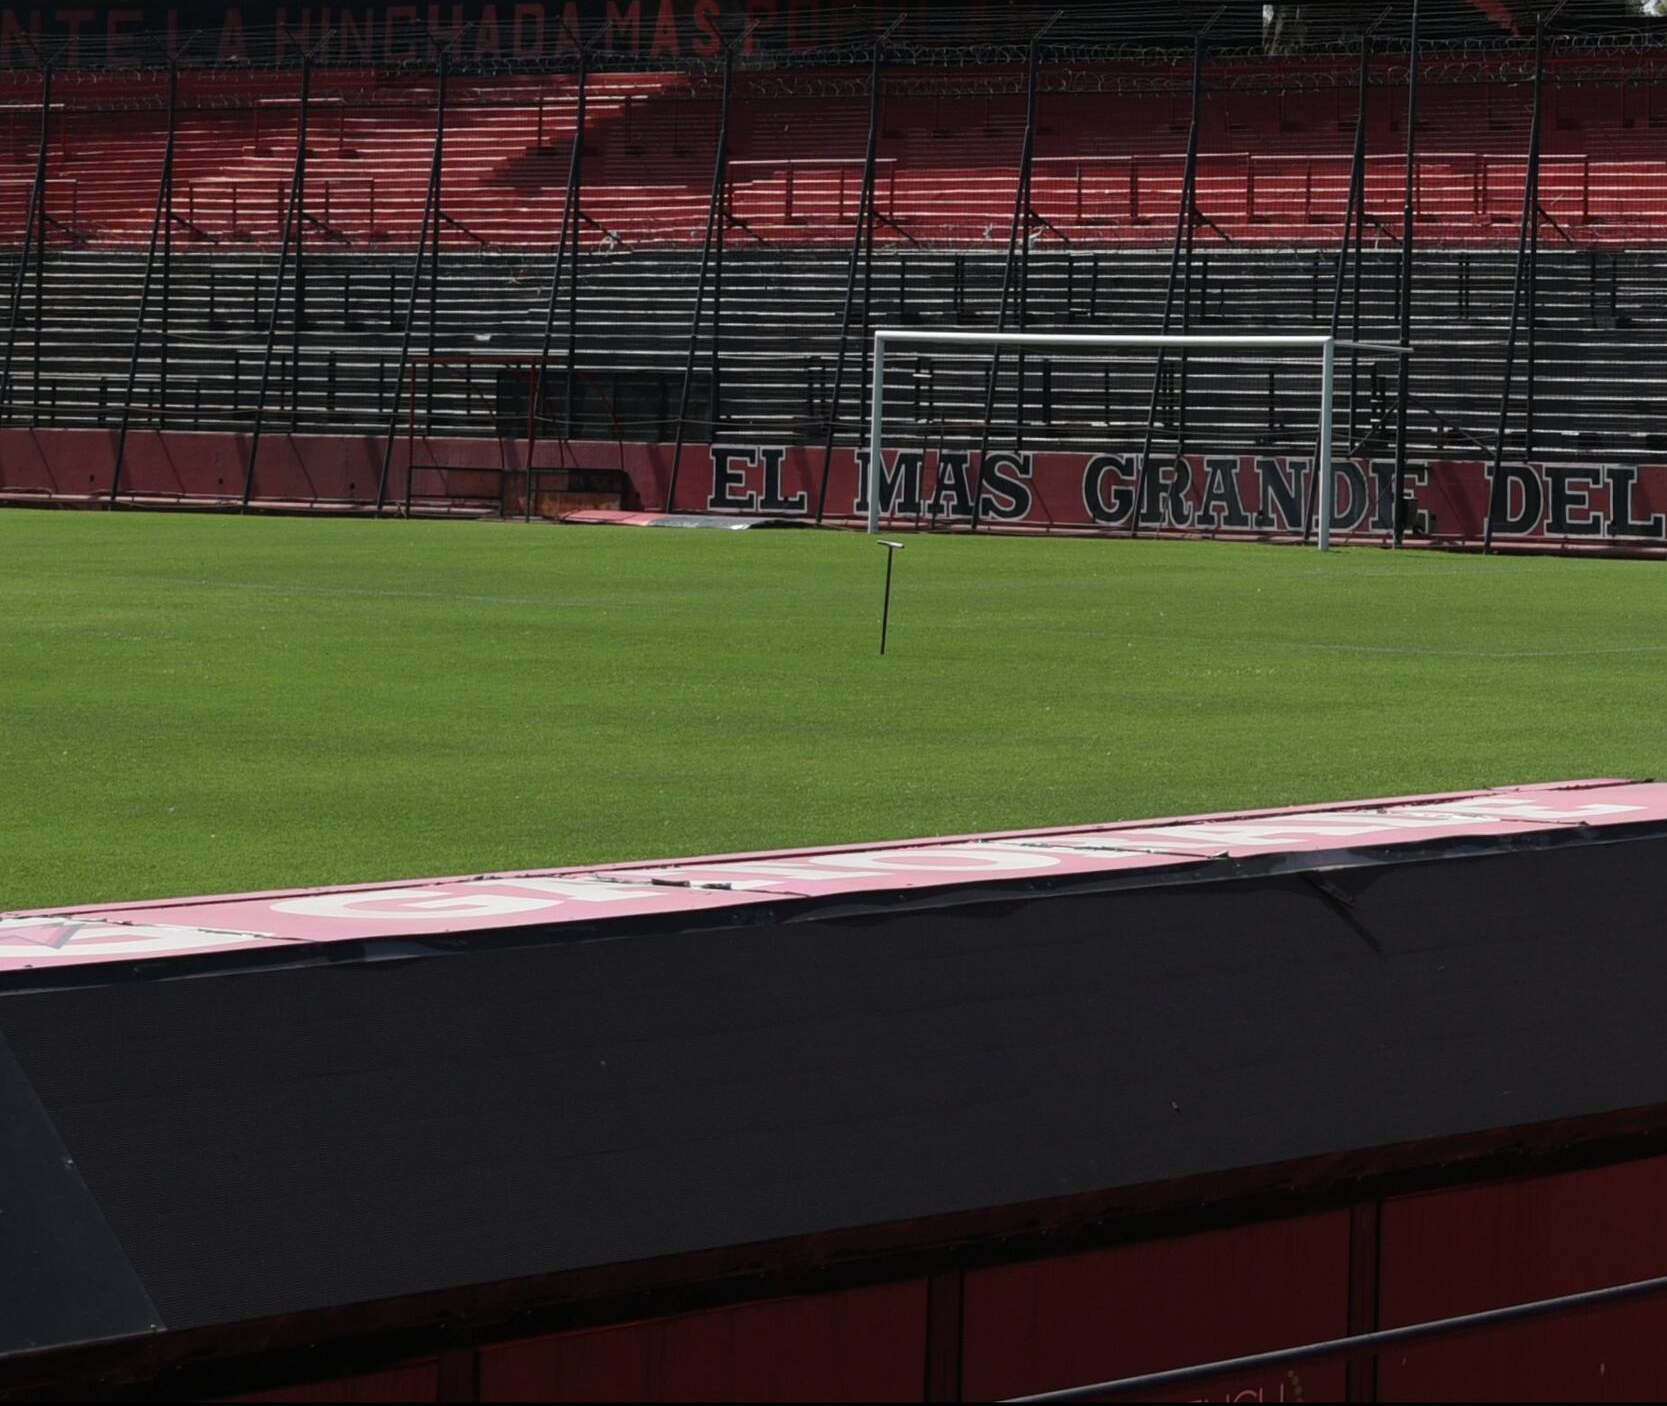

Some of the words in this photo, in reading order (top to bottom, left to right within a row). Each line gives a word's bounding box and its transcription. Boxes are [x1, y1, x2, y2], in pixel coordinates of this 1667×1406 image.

[274, 1, 583, 64] HINCHADA
[707, 444, 808, 515] EL
[855, 447, 1032, 521] MAS
[1081, 453, 1432, 535] GRANDE
[1484, 461, 1665, 540] DEL
